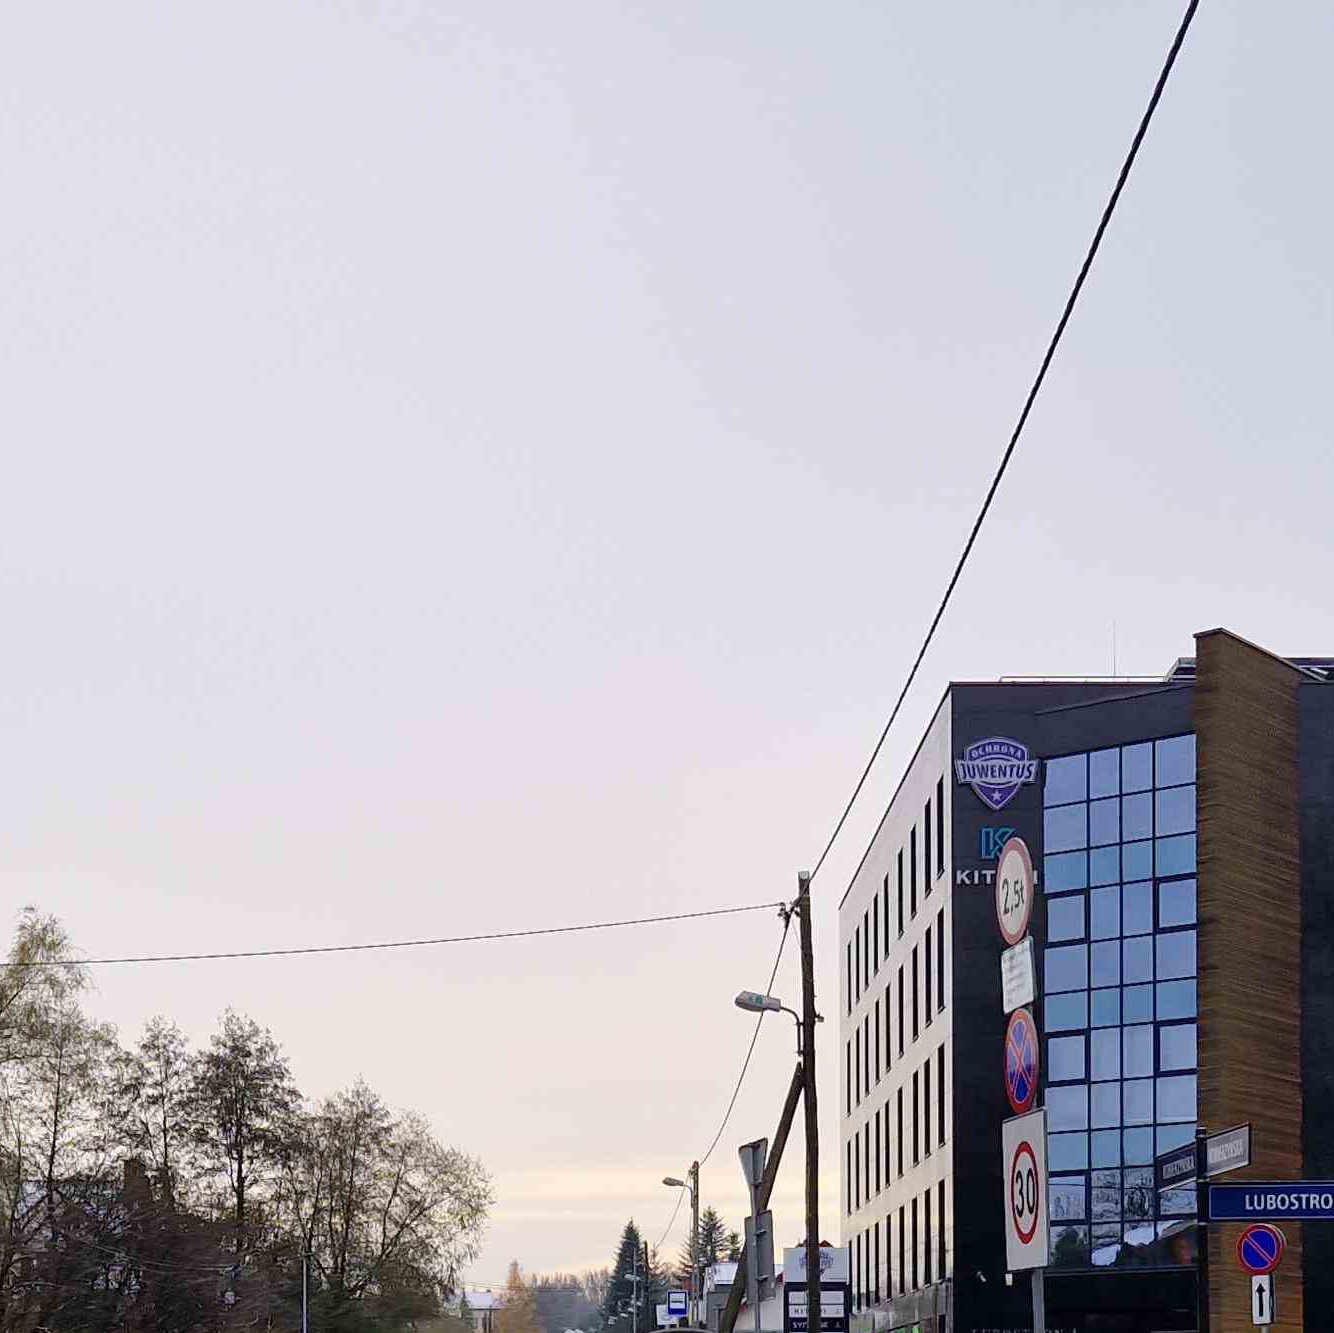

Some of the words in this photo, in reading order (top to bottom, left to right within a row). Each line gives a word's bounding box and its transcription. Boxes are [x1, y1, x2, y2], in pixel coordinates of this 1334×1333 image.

[971, 744, 1022, 759] OCHRONA
[960, 763, 1035, 779] JUWENTUS
[1016, 1168, 1035, 1218] 30
